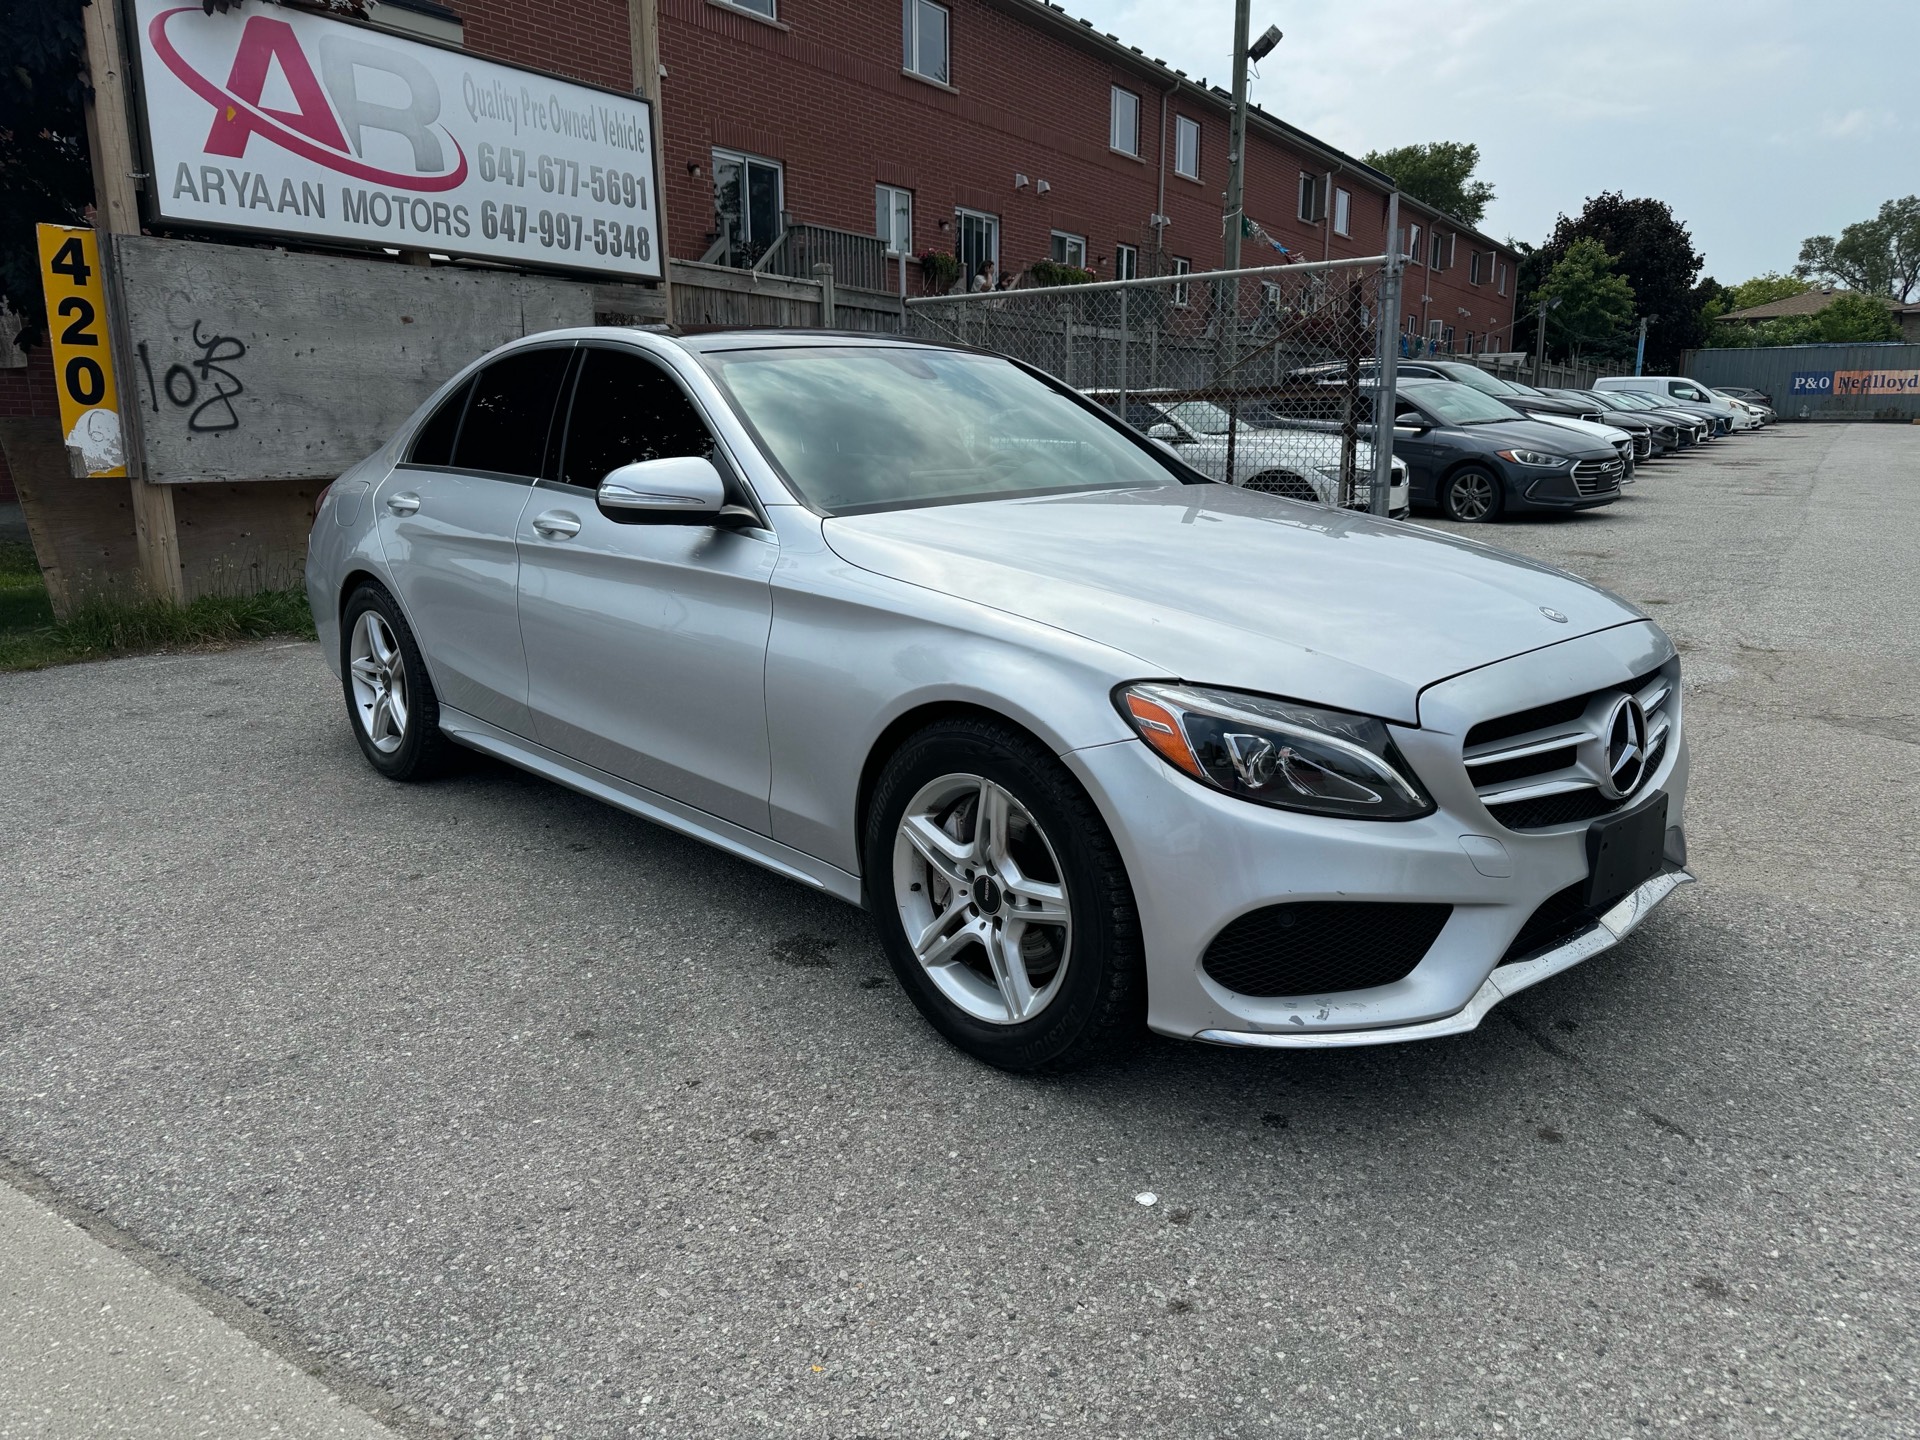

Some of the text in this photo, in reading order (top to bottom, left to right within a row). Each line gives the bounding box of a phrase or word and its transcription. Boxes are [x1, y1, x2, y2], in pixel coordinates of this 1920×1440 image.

[462, 72, 645, 153] Quality Pre Owned Vehicle
[172, 162, 470, 238] ARYAAN MOTORS
[478, 142, 648, 210] 647-677-5691
[481, 200, 651, 261] 647-997-5348
[51, 237, 105, 406] 420
[1794, 374, 1919, 391] P&O Nedlloyd
